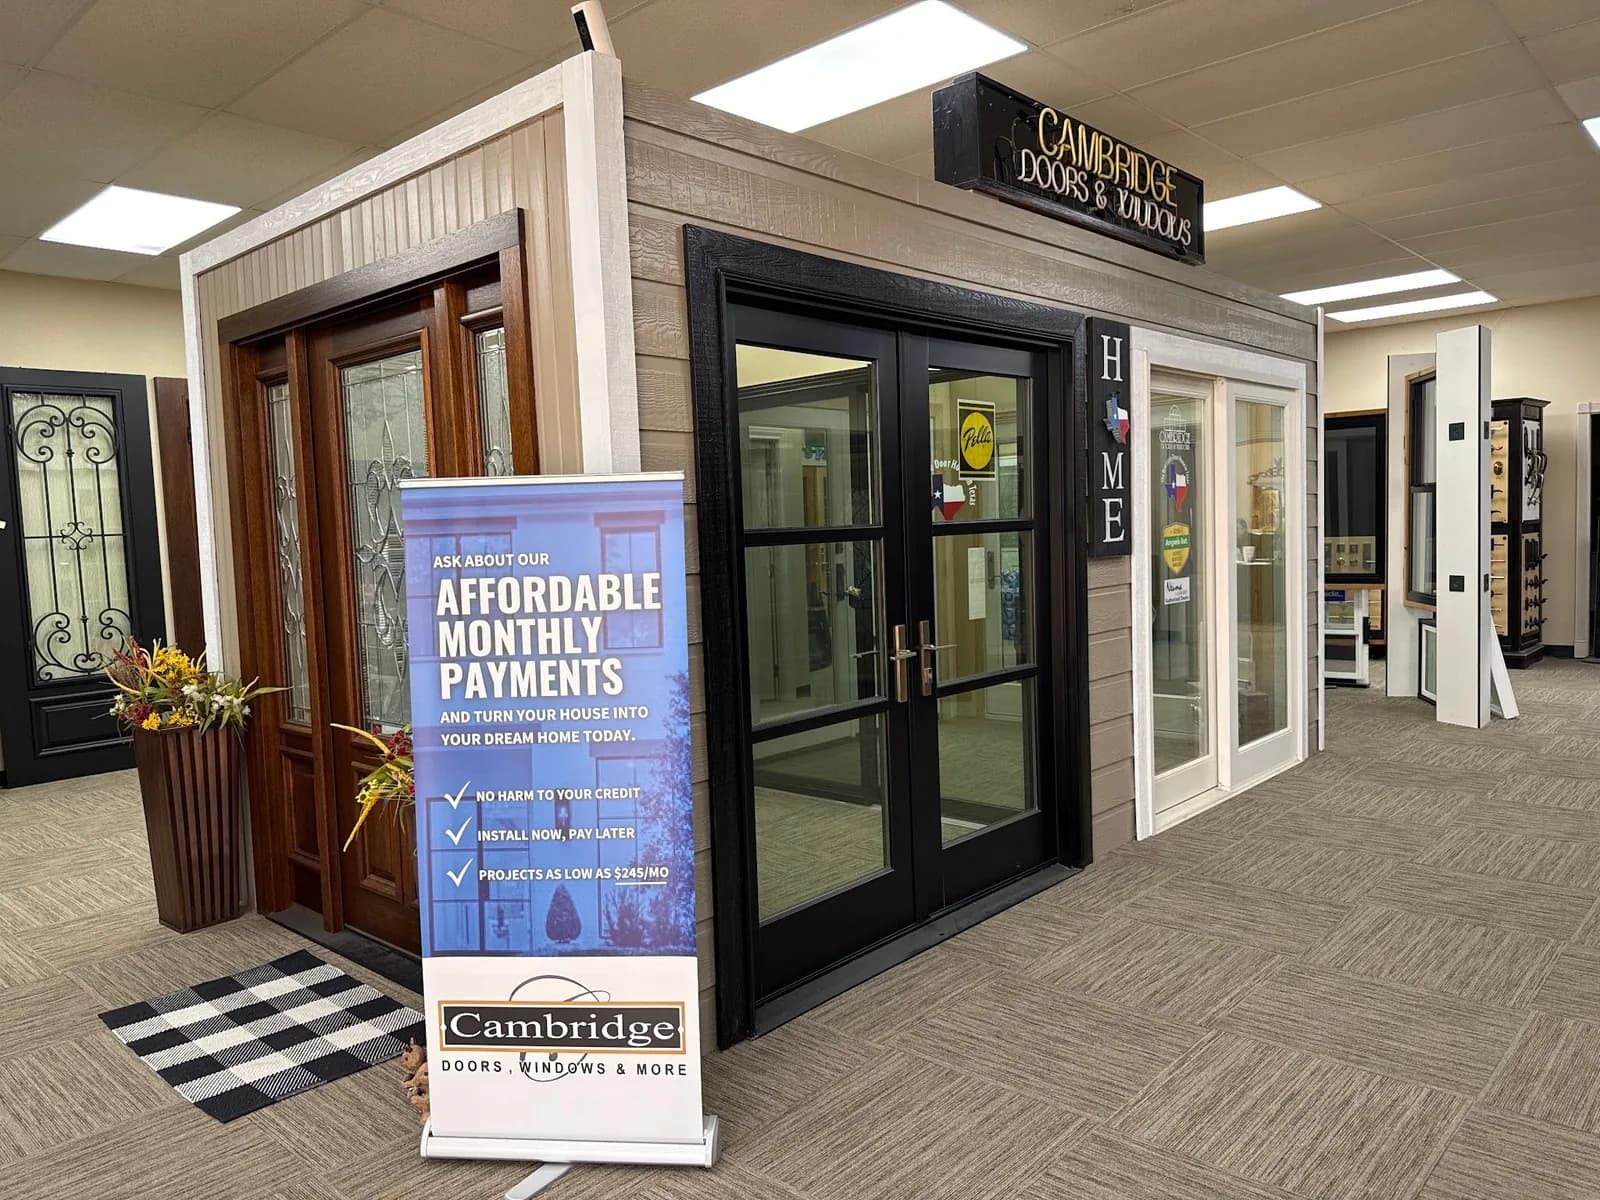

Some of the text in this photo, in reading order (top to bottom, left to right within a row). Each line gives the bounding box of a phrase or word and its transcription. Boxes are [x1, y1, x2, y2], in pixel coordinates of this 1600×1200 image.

[1038, 107, 1178, 207] CAMBRIDGE
[1017, 148, 1089, 202] DOORS
[1094, 180, 1107, 209] &
[962, 425, 992, 453] Pella
[934, 459, 951, 469] Door
[968, 484, 977, 506] Texas
[433, 553, 549, 568] ASK ABOUT OUR
[436, 572, 661, 616] AFFORDABLE
[438, 616, 602, 657] MONTHLY
[440, 657, 624, 700] PAYMENTS
[440, 706, 648, 724] AND TURN YOUR HOUSE INTO
[440, 729, 635, 746] YOUR DREAM HOME TODAY.
[476, 787, 640, 802] NO HARM TO YOUR CREDIT
[477, 827, 635, 842] INSTALL NOW, PAY LATER
[479, 866, 669, 881] PROJECTS AS LOW AS $245/MO
[450, 1012, 675, 1047] Cambridge
[519, 1061, 606, 1075] WINDOWS
[616, 1063, 626, 1075] &
[636, 1063, 688, 1076] MORE
